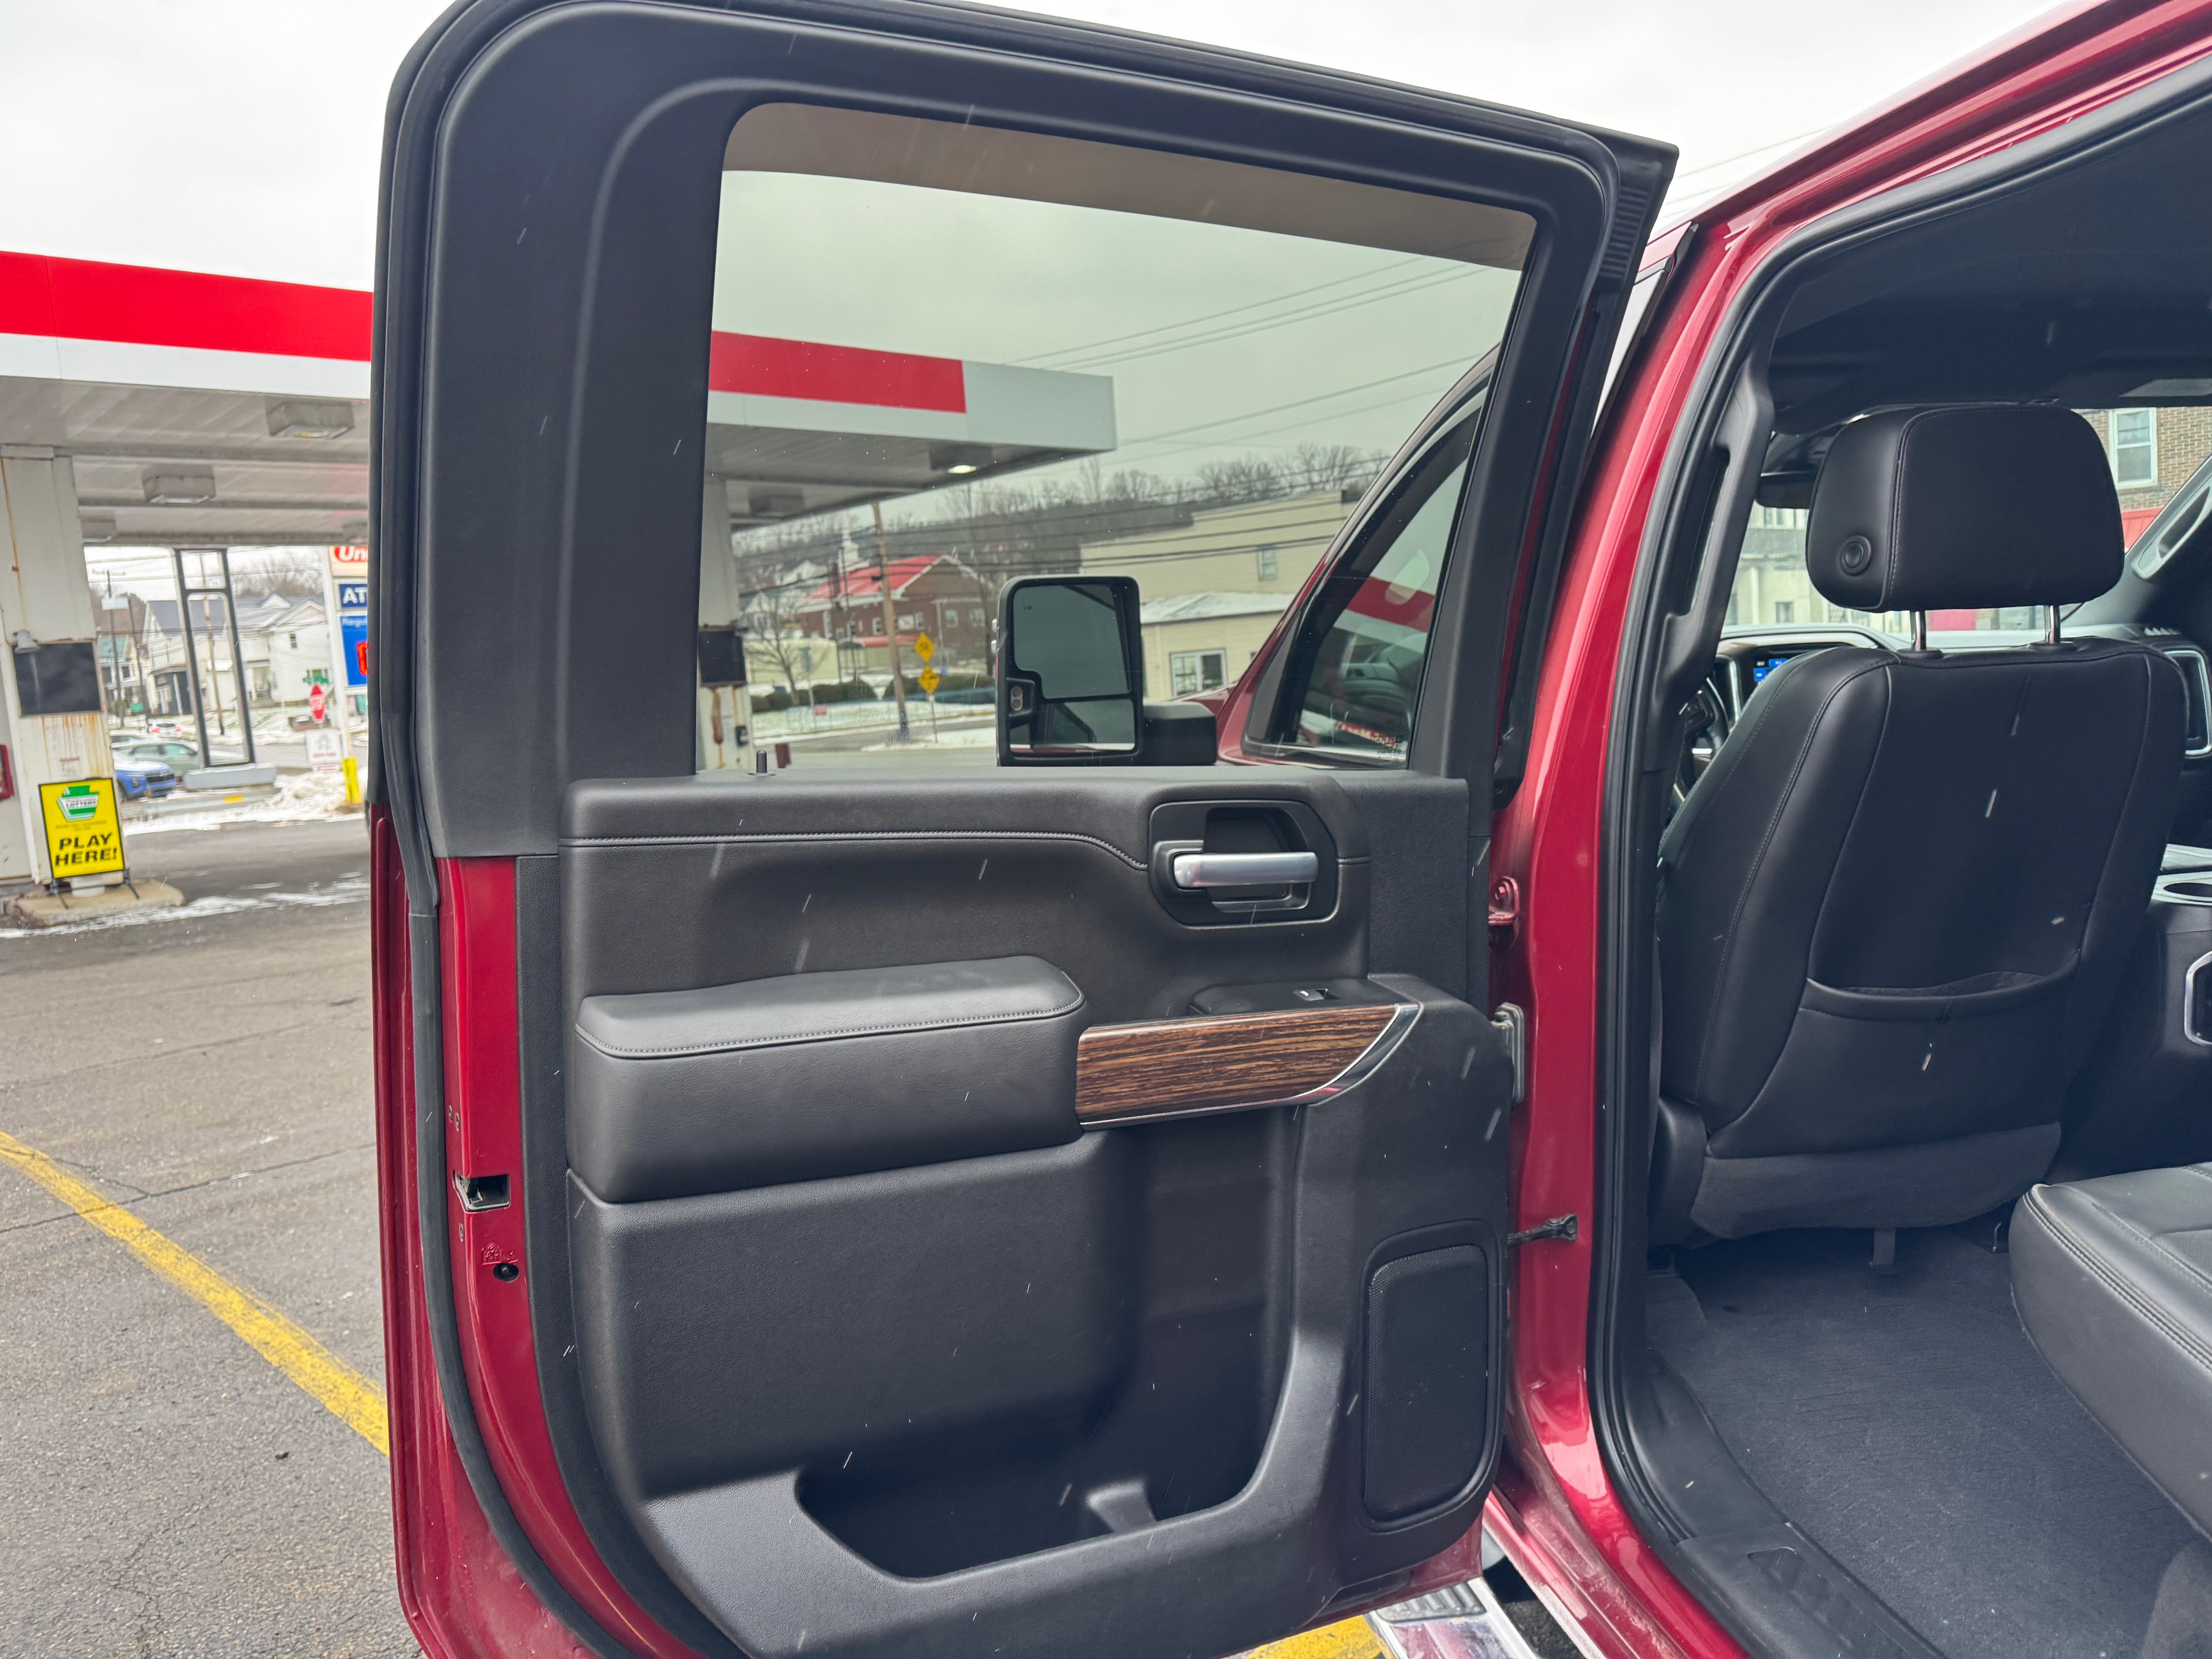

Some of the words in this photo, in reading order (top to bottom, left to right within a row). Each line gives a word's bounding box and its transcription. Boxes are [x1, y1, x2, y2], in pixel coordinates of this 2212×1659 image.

[339, 546, 368, 561] Un
[343, 587, 368, 604] AT
[59, 833, 112, 849] PLAY
[55, 848, 117, 865] HERE!
